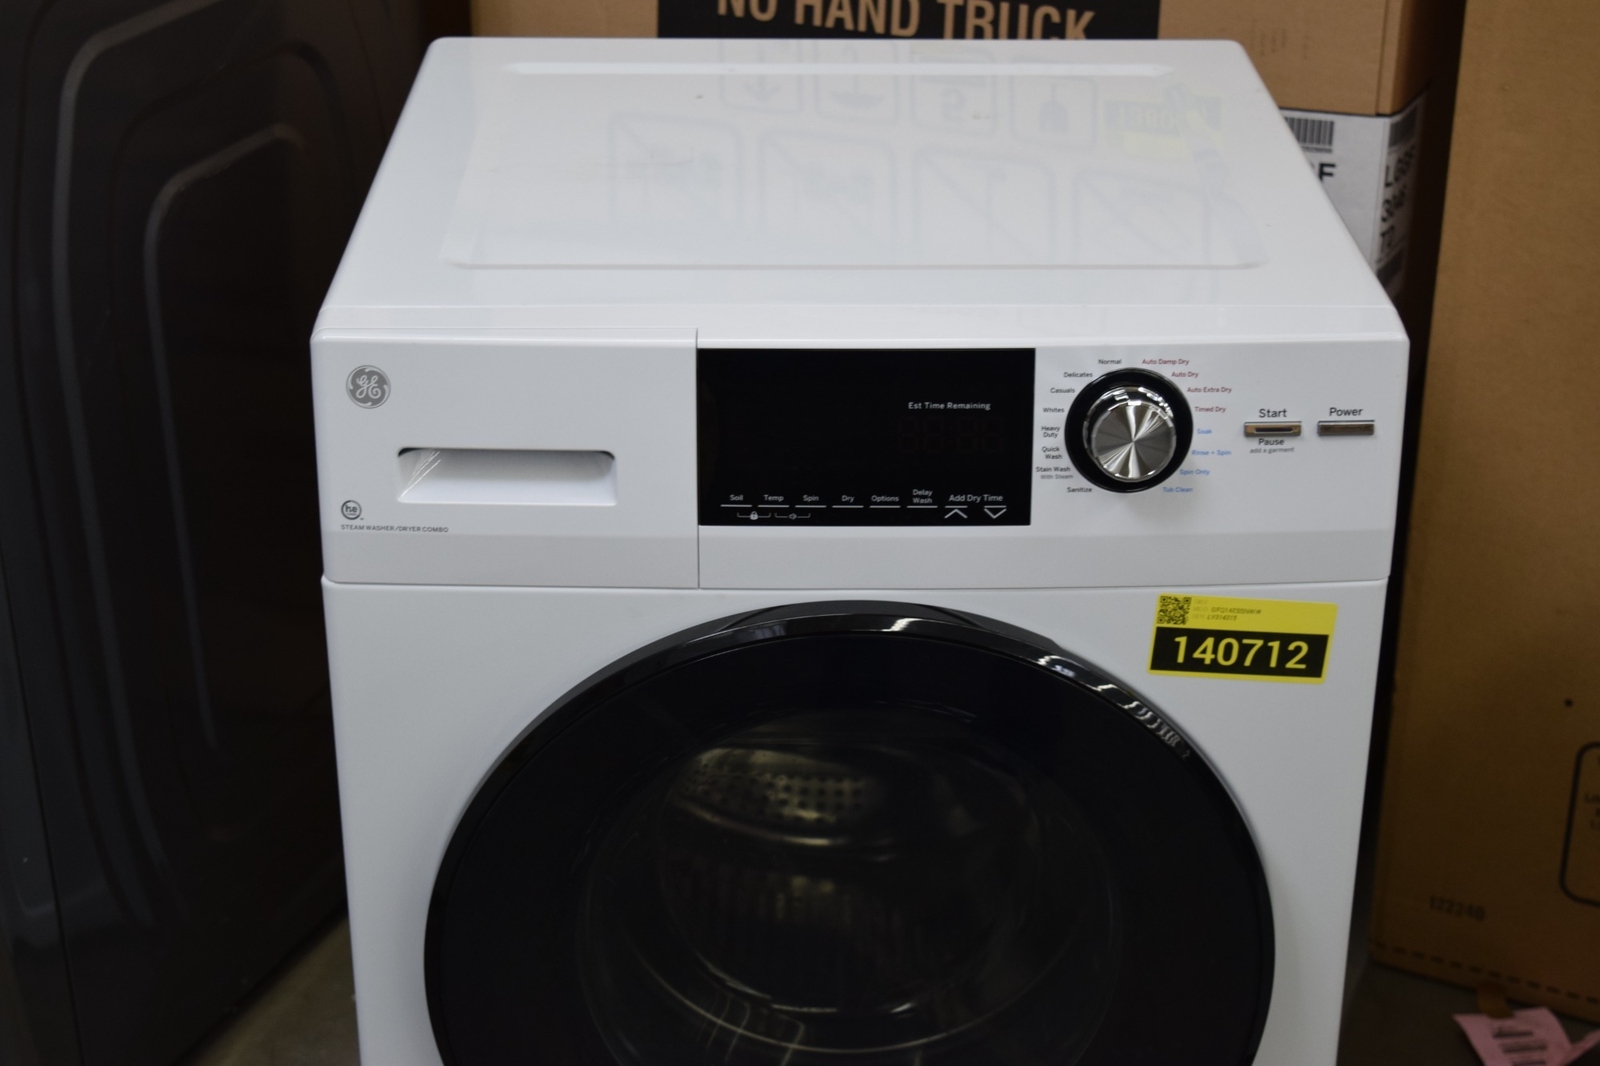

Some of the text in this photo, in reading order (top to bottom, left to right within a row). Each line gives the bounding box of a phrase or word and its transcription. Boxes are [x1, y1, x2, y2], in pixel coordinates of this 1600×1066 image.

[793, 0, 921, 38] HAND
[936, 0, 1096, 39] TRUCK
[1158, 358, 1177, 366] Damp
[1178, 358, 1190, 366] Dry
[1187, 371, 1199, 379] Dry
[1220, 386, 1233, 394] Dry
[908, 402, 991, 411] Est Time Remaining
[1258, 408, 1287, 418] Start
[1328, 407, 1363, 417] Power
[1258, 437, 1285, 446] Pause
[1195, 468, 1211, 476] Only
[912, 488, 933, 497] Delay
[763, 494, 784, 503] Temp
[803, 494, 819, 503] Spin
[841, 494, 855, 503] Dry
[871, 494, 899, 503] Options
[949, 494, 1003, 503] Add Dry Time
[1174, 635, 1309, 670] 140712
